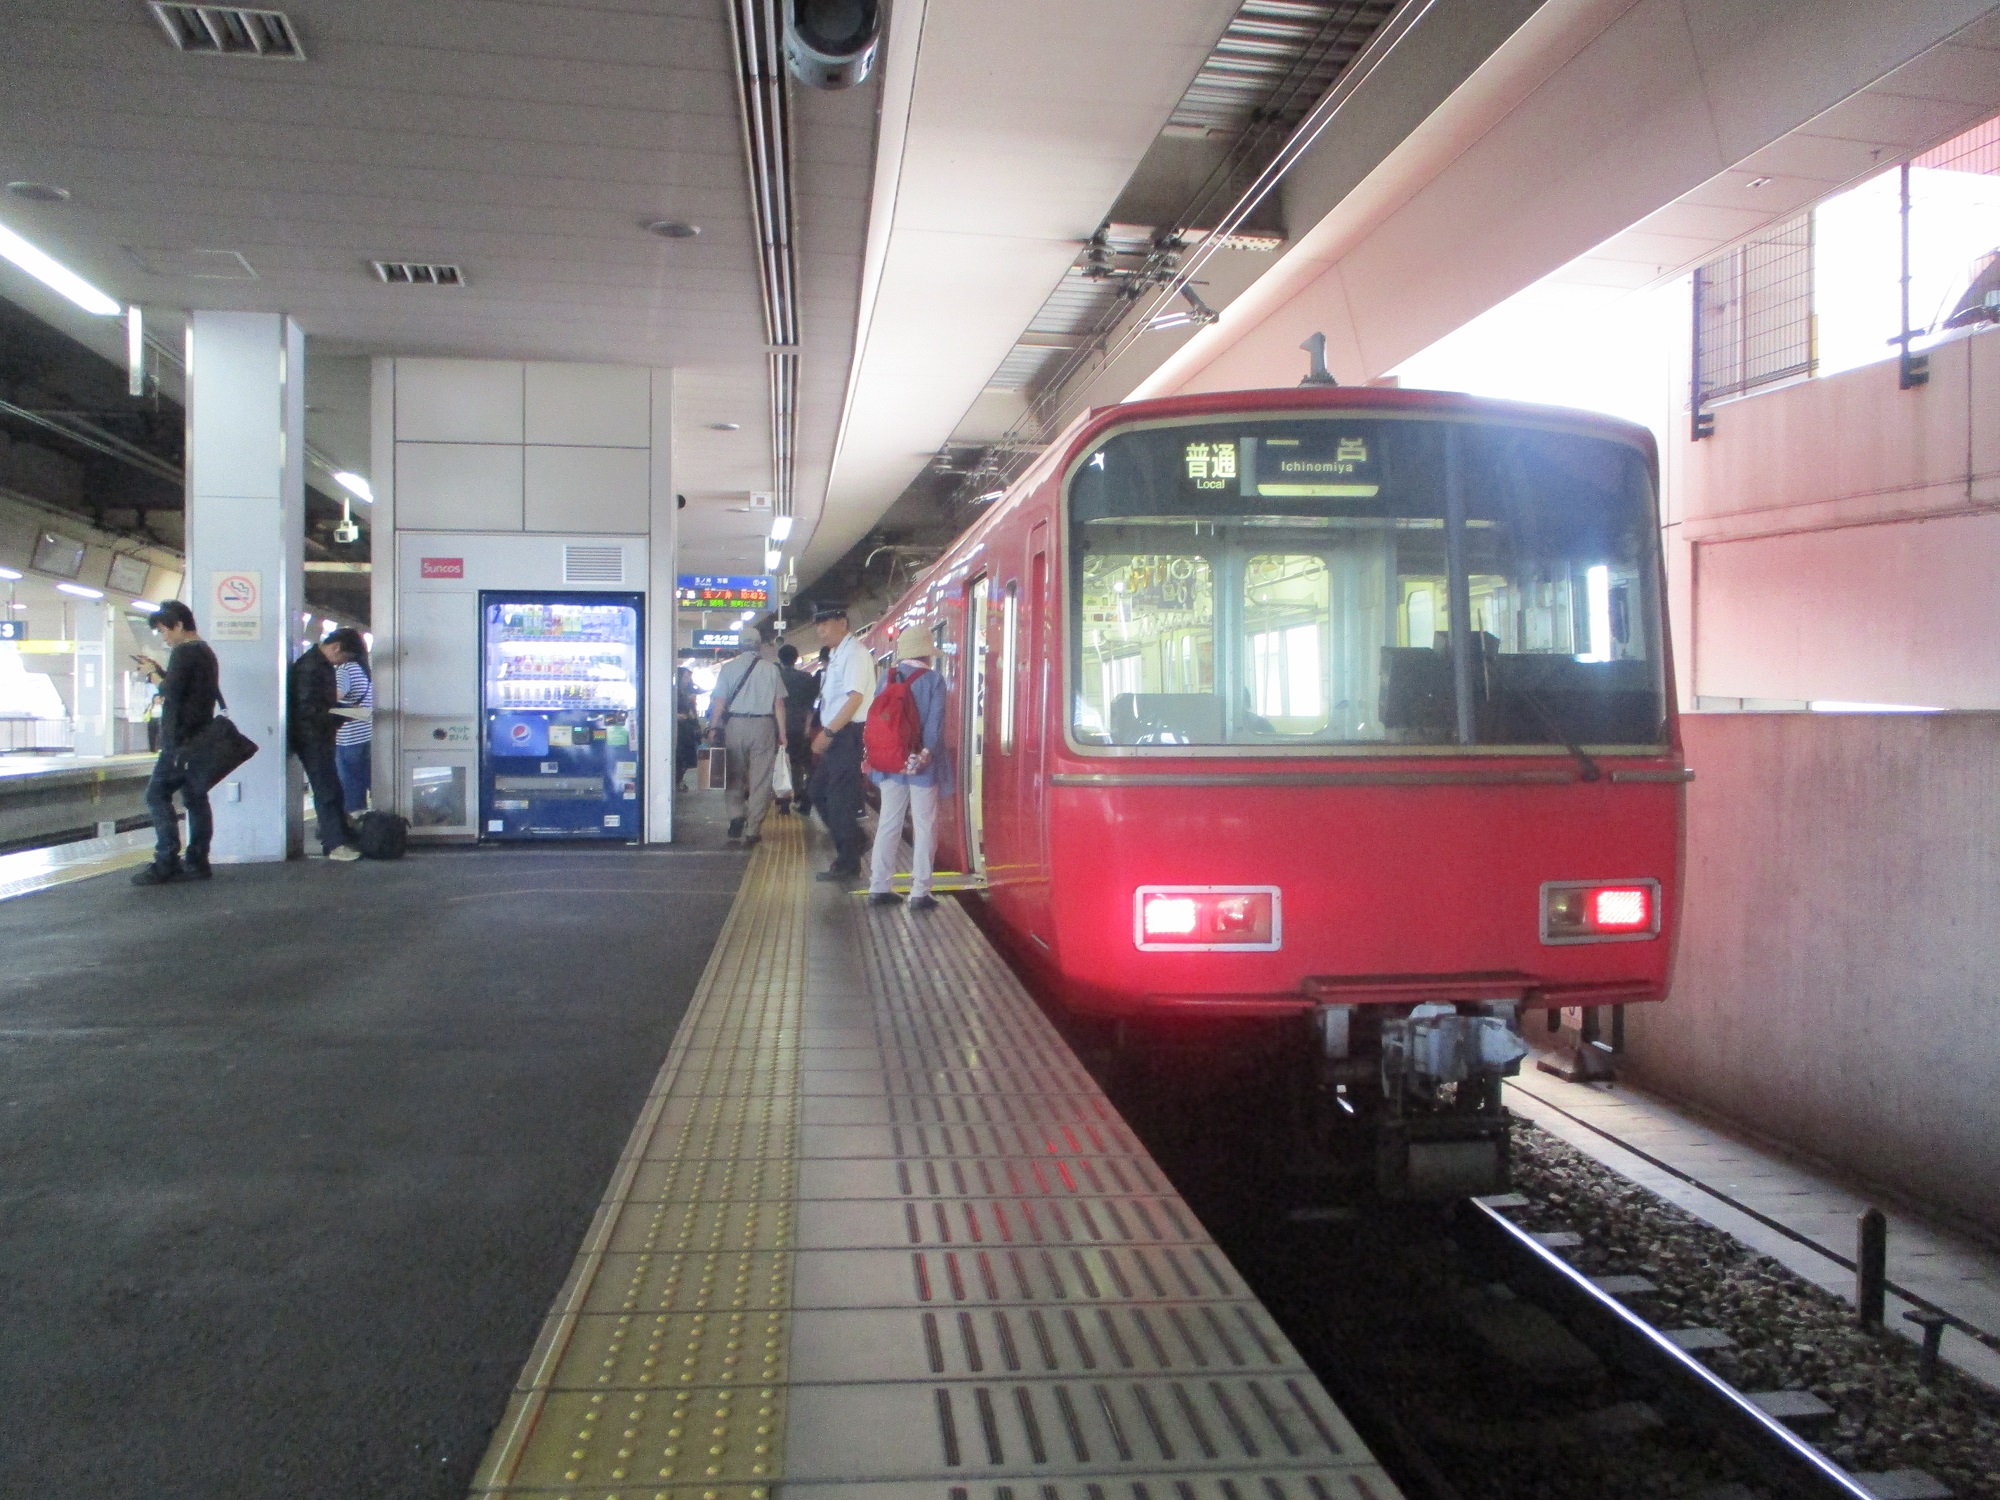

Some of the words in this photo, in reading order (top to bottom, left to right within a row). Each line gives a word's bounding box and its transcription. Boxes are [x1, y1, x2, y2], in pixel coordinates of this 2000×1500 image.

[1186, 442, 1237, 479] 普通
[1281, 462, 1353, 474] Ichinomiya
[1197, 478, 1225, 490] Local
[423, 562, 461, 574] Suncos
